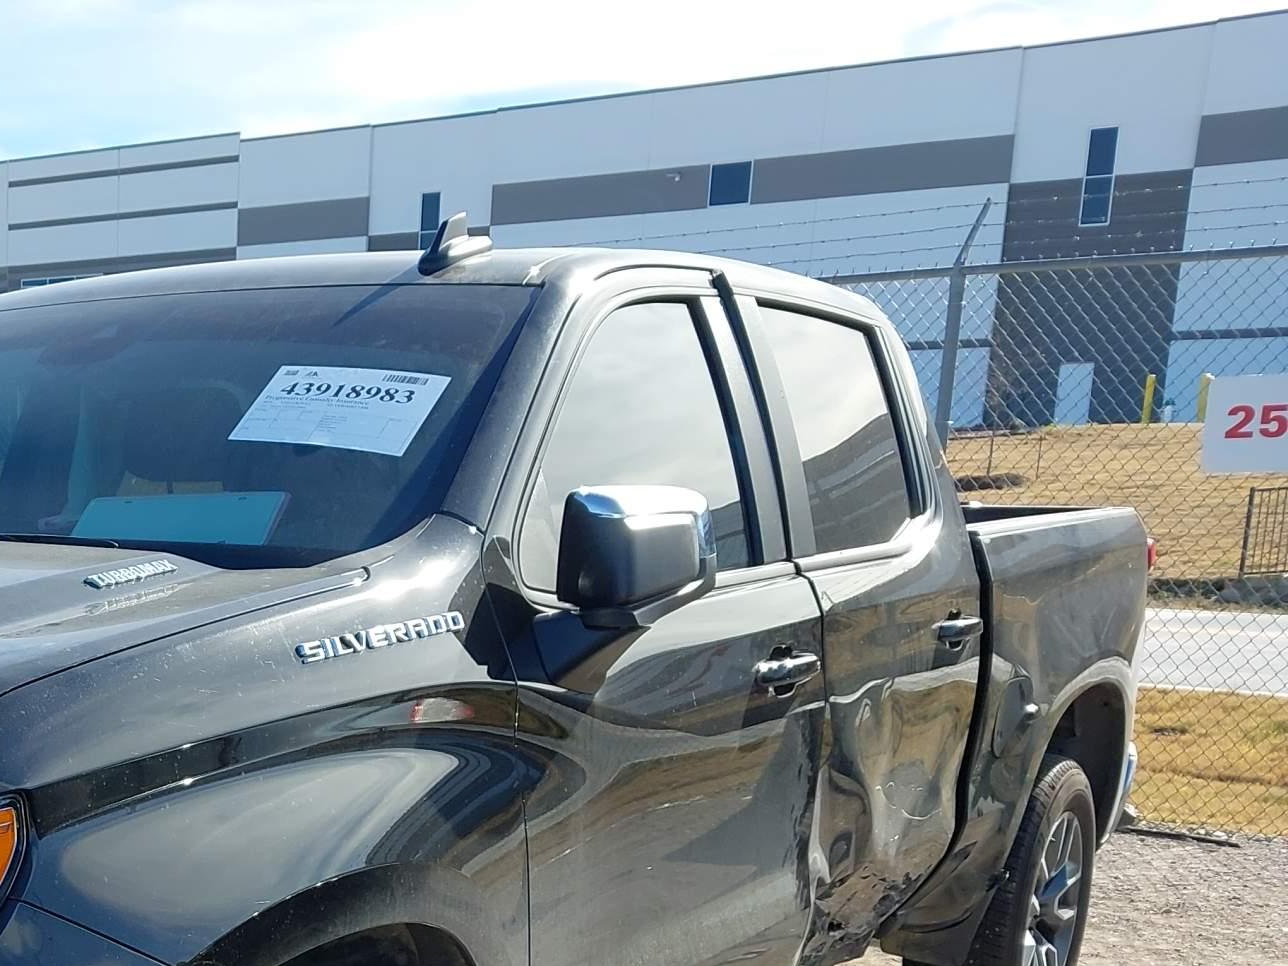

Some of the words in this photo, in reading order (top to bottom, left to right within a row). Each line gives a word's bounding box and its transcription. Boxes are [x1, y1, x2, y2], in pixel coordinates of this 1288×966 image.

[280, 381, 416, 405] 43918983
[1224, 404, 1288, 439] 25
[83, 559, 178, 589] TURBOMAX
[295, 611, 465, 664] SILVERADO
